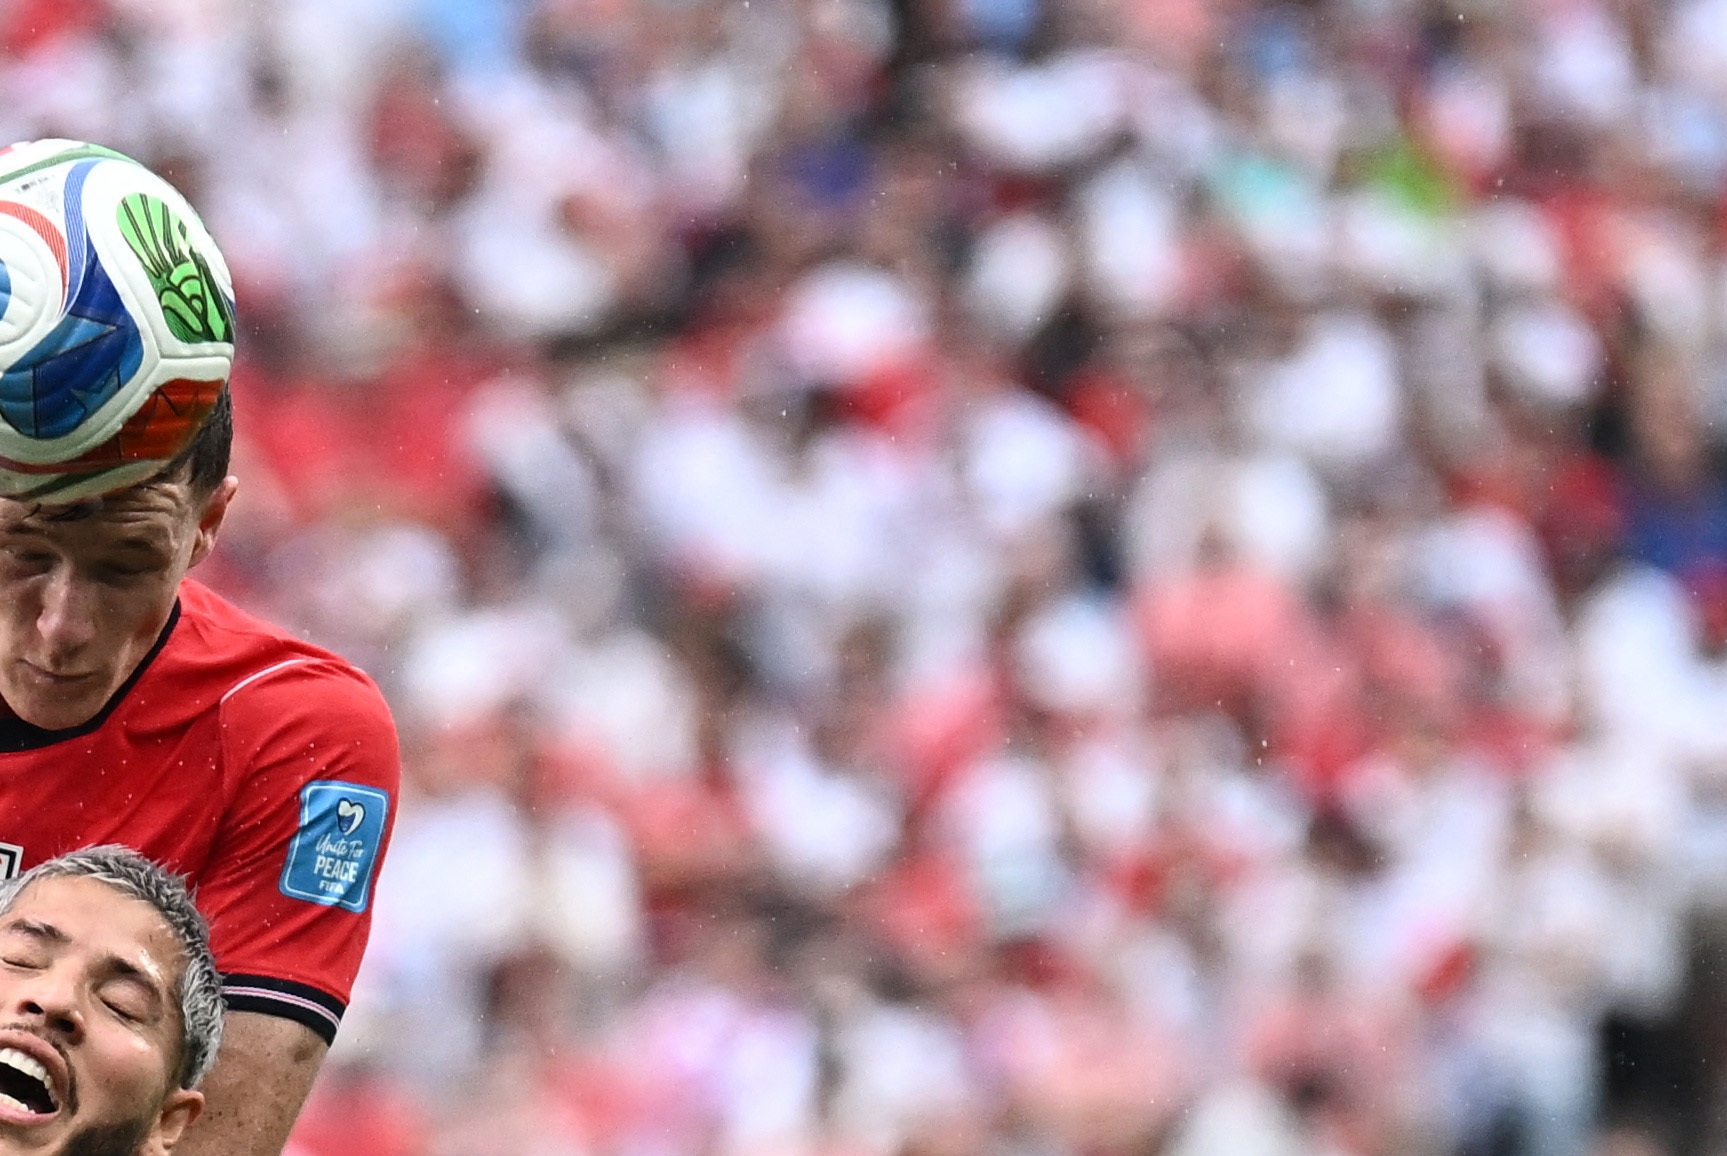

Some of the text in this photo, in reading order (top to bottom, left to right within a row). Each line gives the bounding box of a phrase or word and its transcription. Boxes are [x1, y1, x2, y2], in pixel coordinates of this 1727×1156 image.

[315, 833, 348, 856] Unite
[314, 855, 359, 882] PEACE
[319, 880, 345, 894] FIFA
